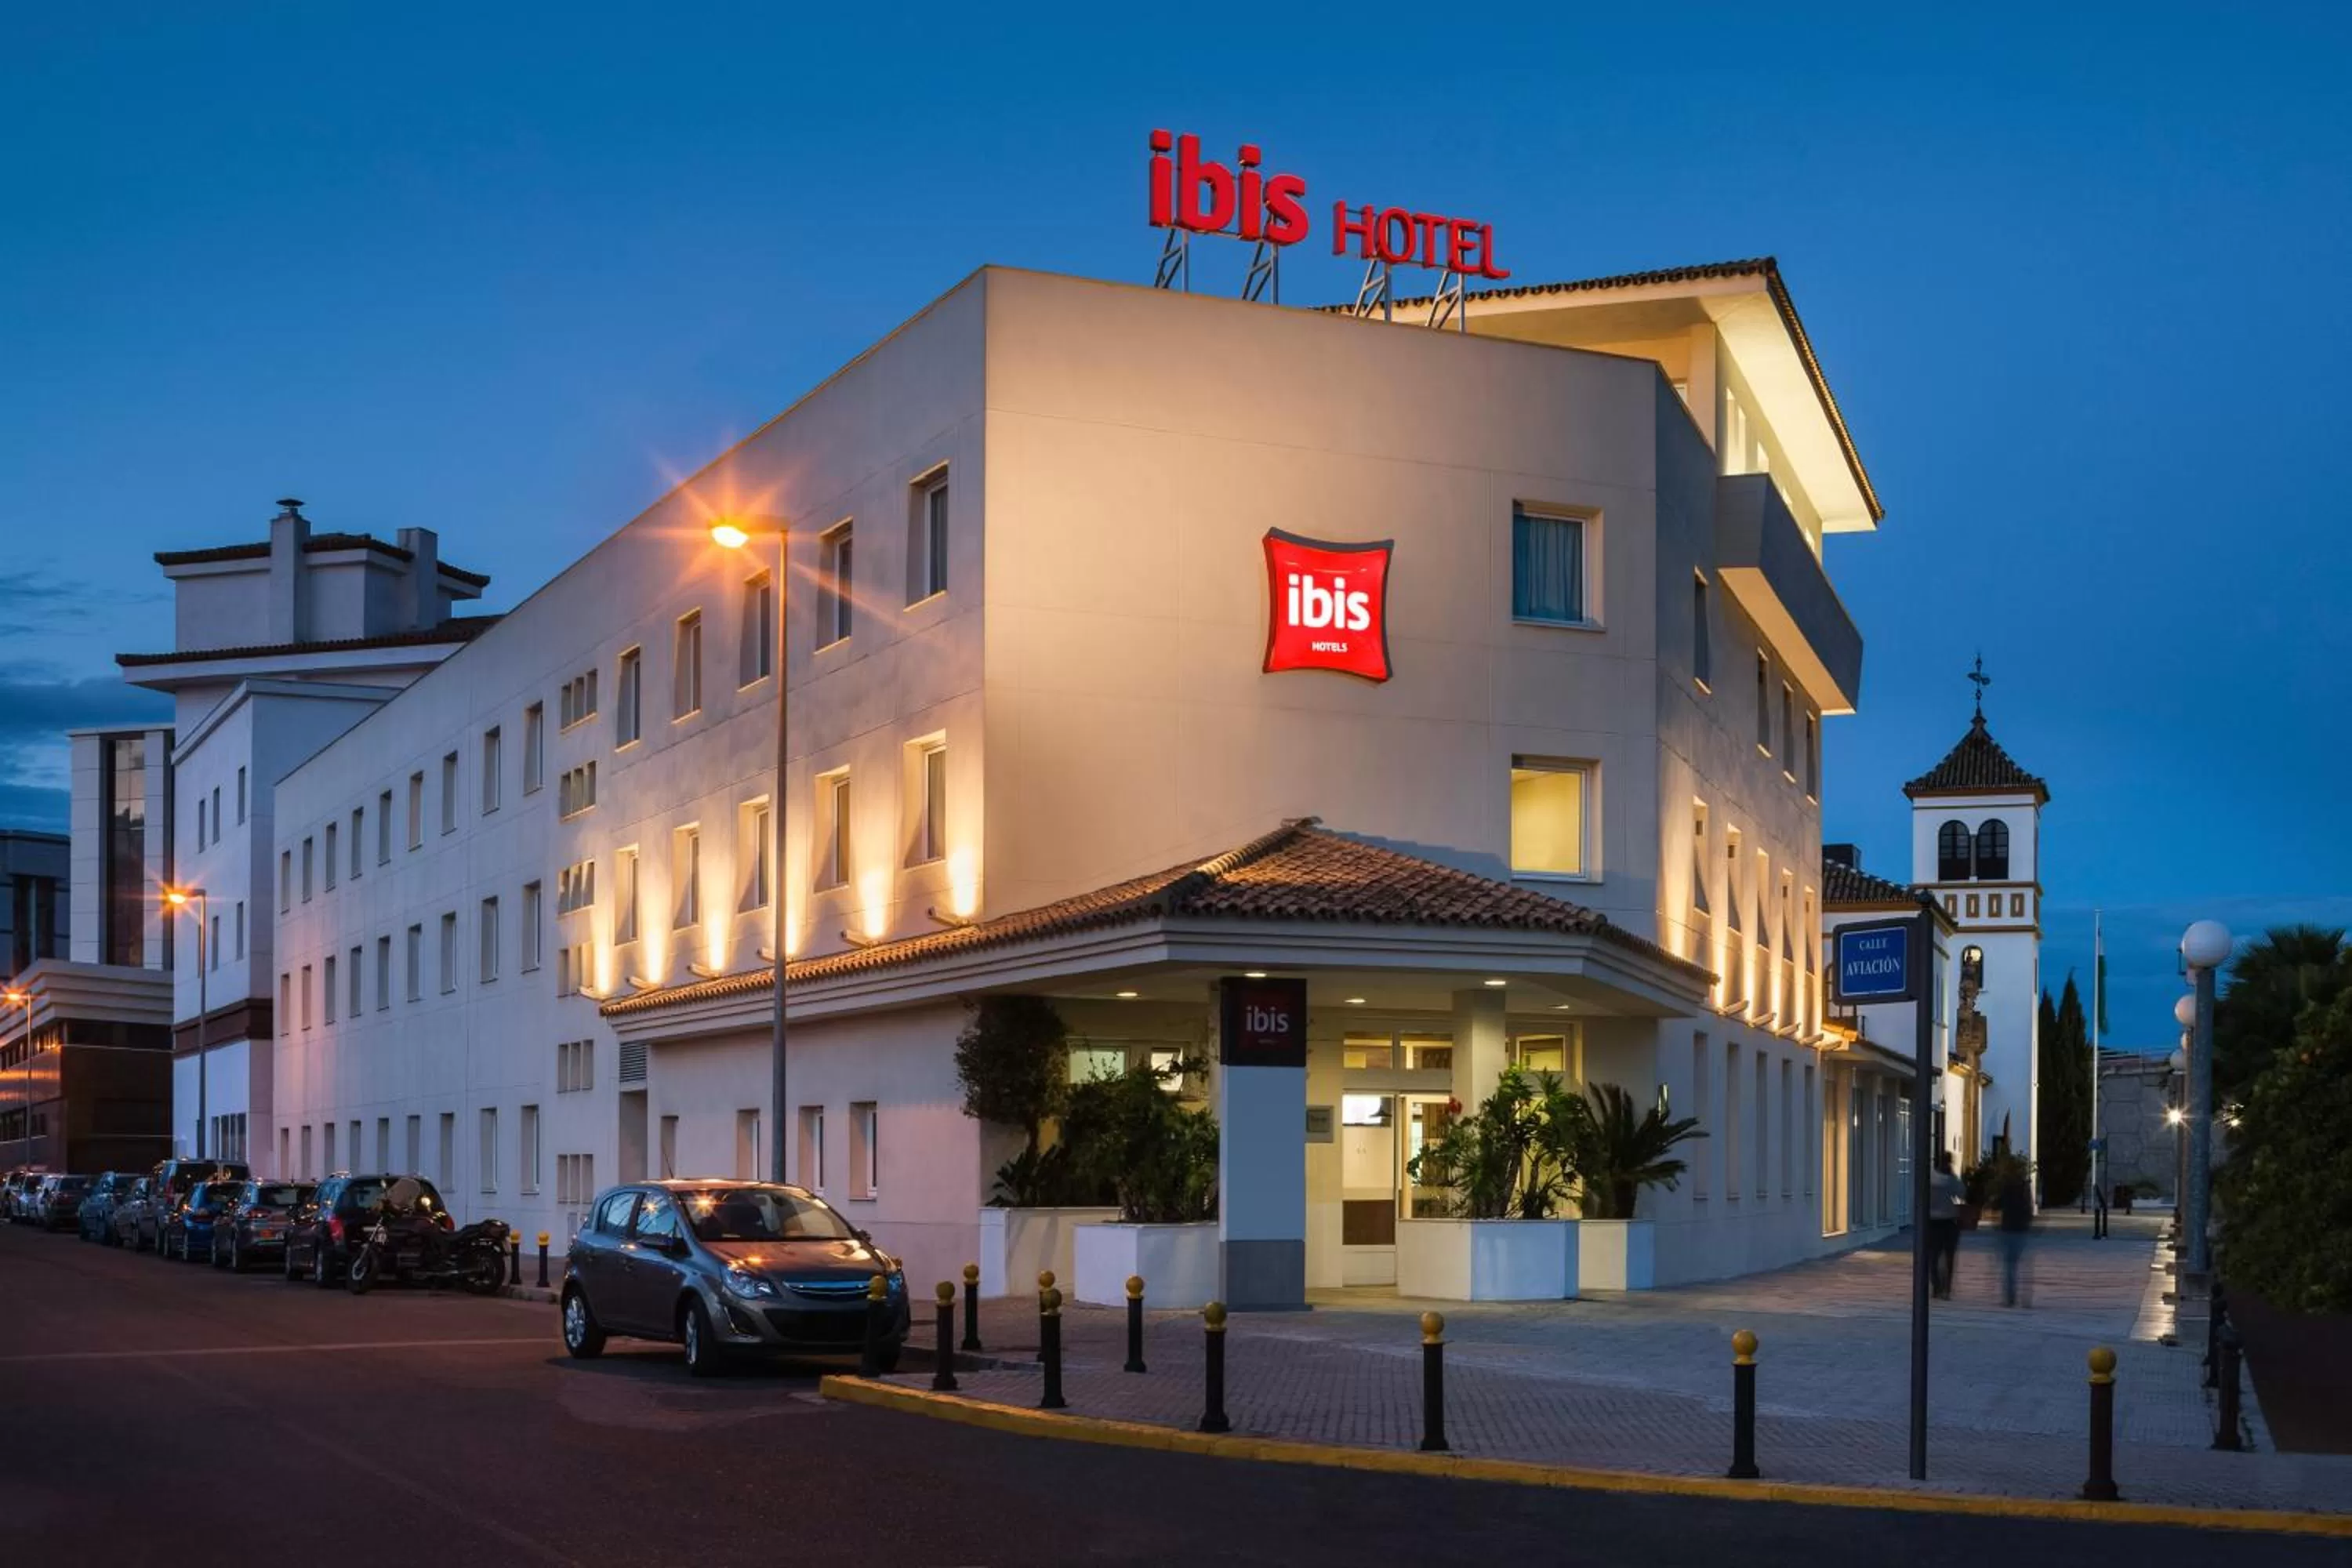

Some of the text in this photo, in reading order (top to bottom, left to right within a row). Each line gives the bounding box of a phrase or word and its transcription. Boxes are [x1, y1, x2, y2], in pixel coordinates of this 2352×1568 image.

[1149, 129, 1511, 279] ibis HOTEL
[1287, 573, 1370, 631] ibis
[1311, 641, 1348, 652] HOTELS
[1846, 956, 1901, 977] AVIACIÓN
[1245, 1006, 1290, 1033] ibis
